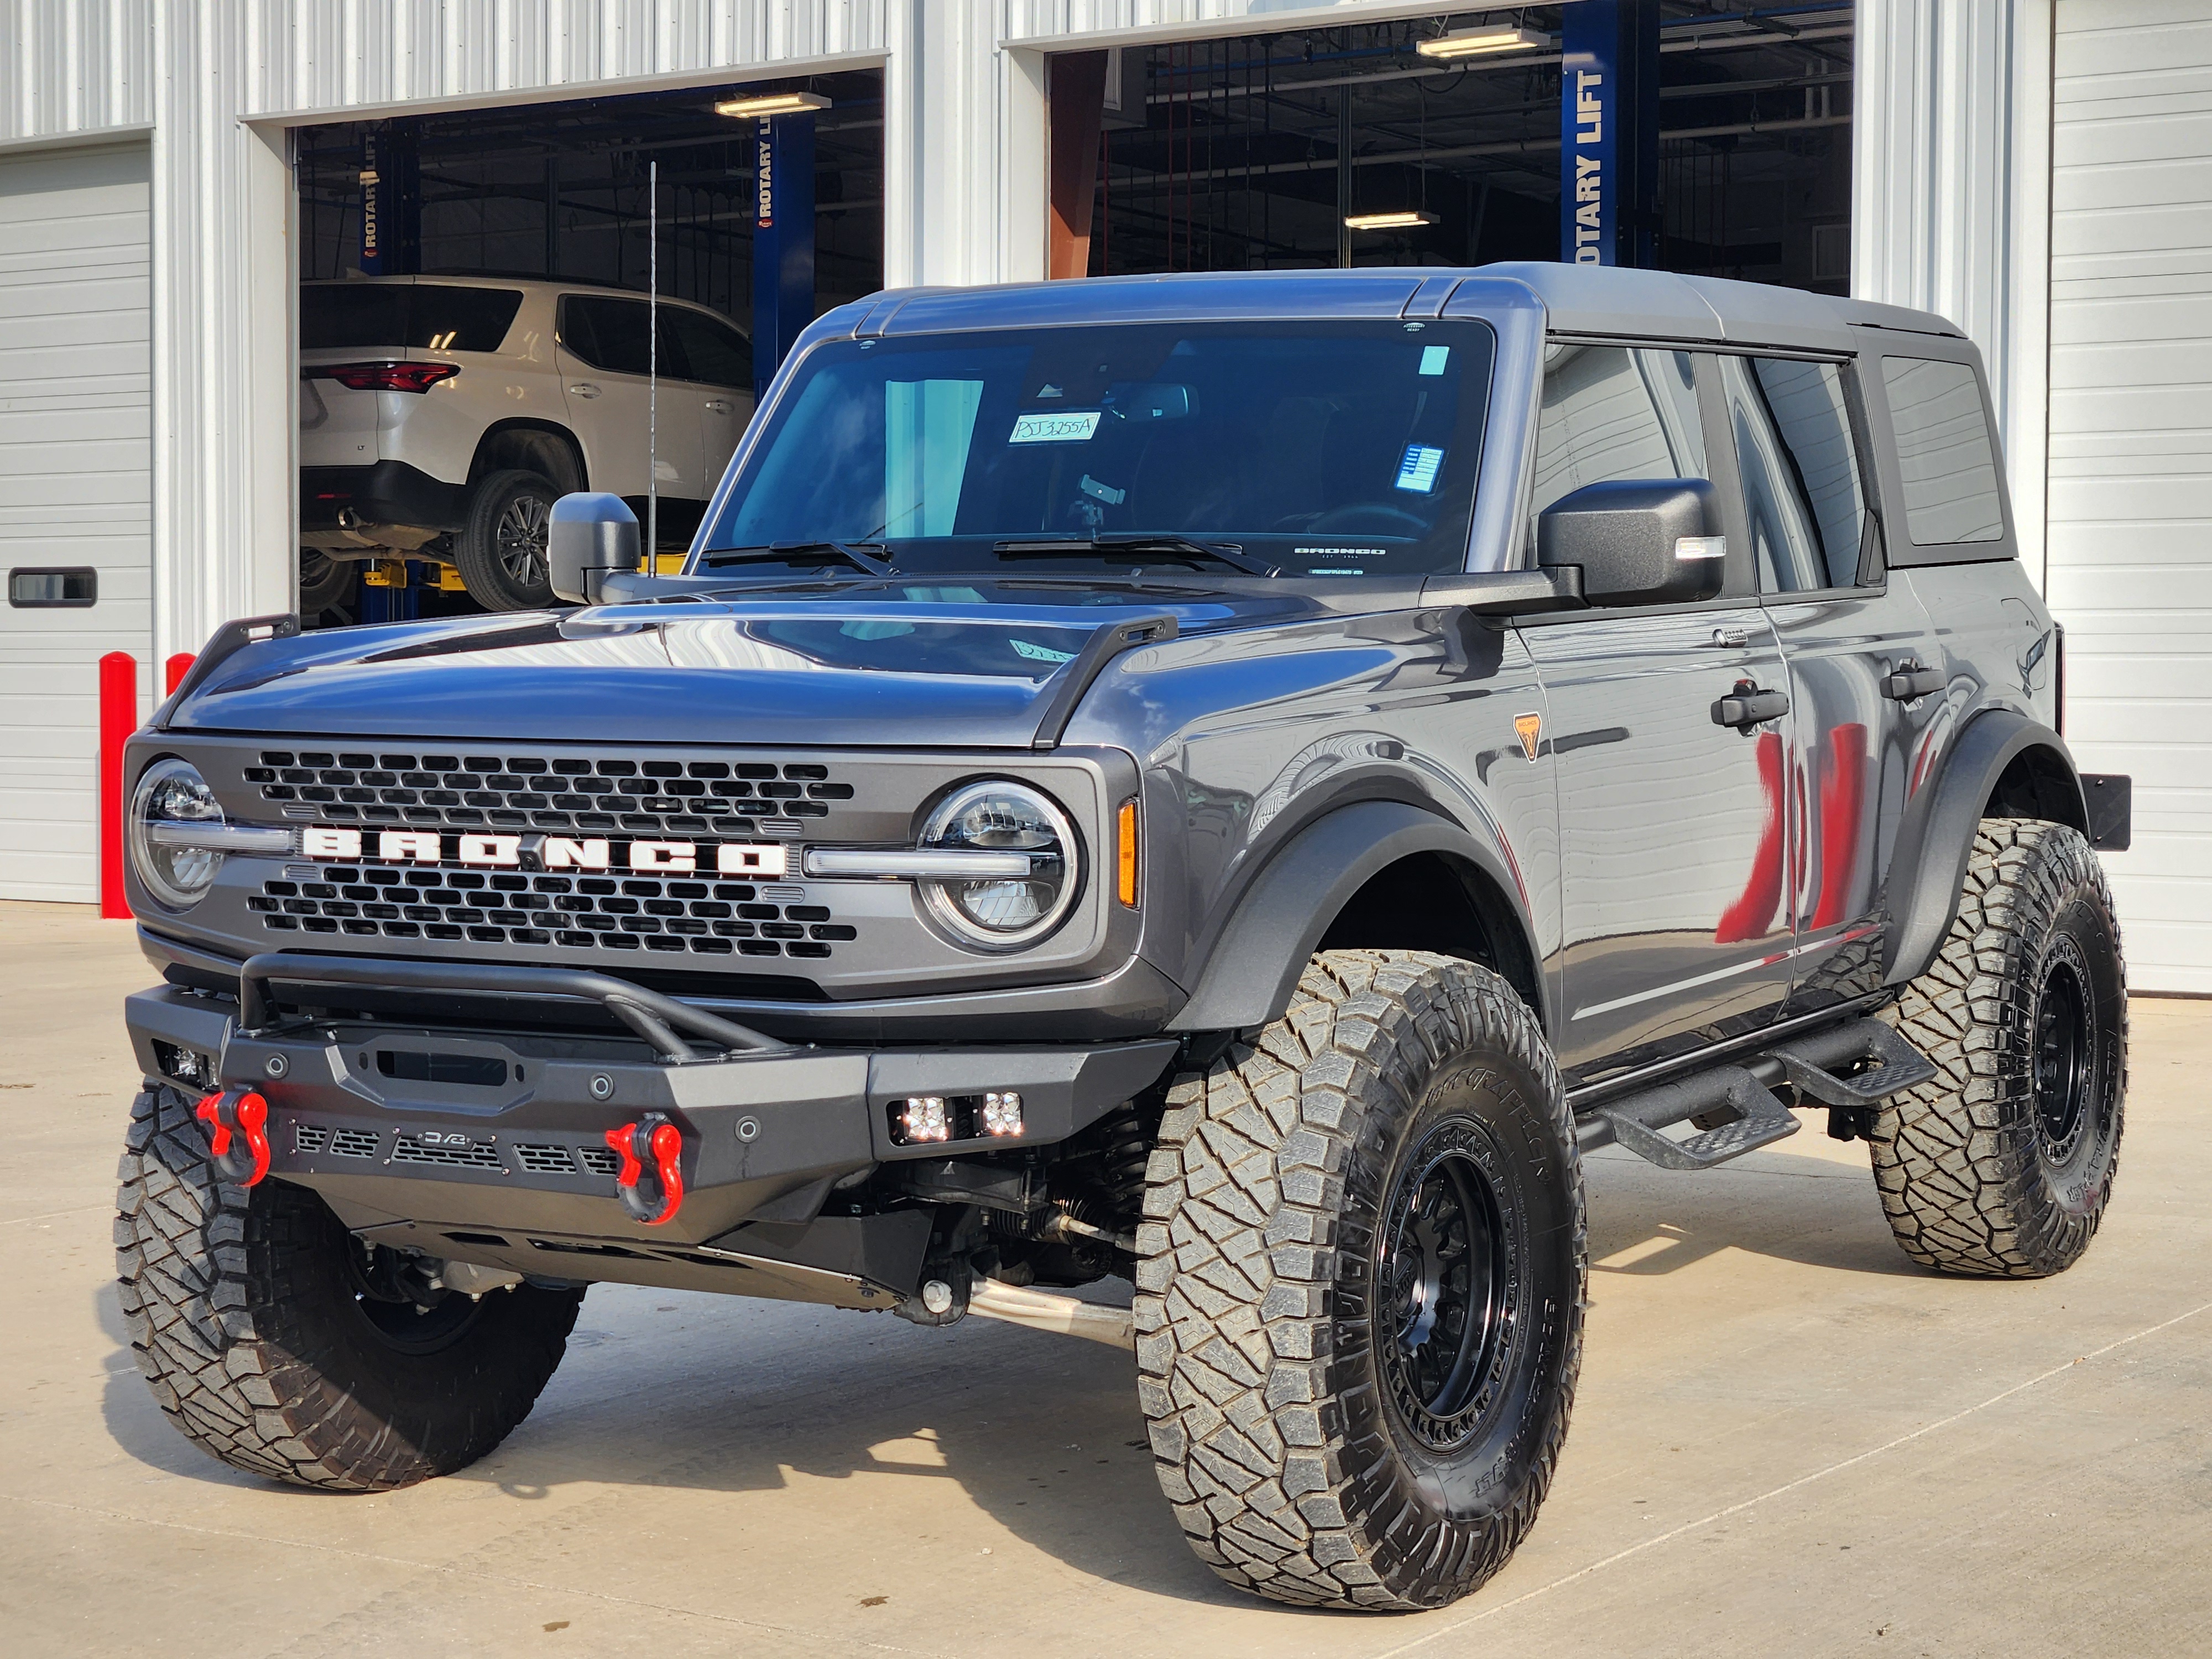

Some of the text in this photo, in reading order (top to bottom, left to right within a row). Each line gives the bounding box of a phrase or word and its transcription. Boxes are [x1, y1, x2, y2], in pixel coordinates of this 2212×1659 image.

[759, 115, 771, 217] ROTARY LI
[1575, 70, 1602, 265] OTARY LIFT
[365, 181, 376, 247] ROTAR
[303, 827, 785, 875] BRONCO
